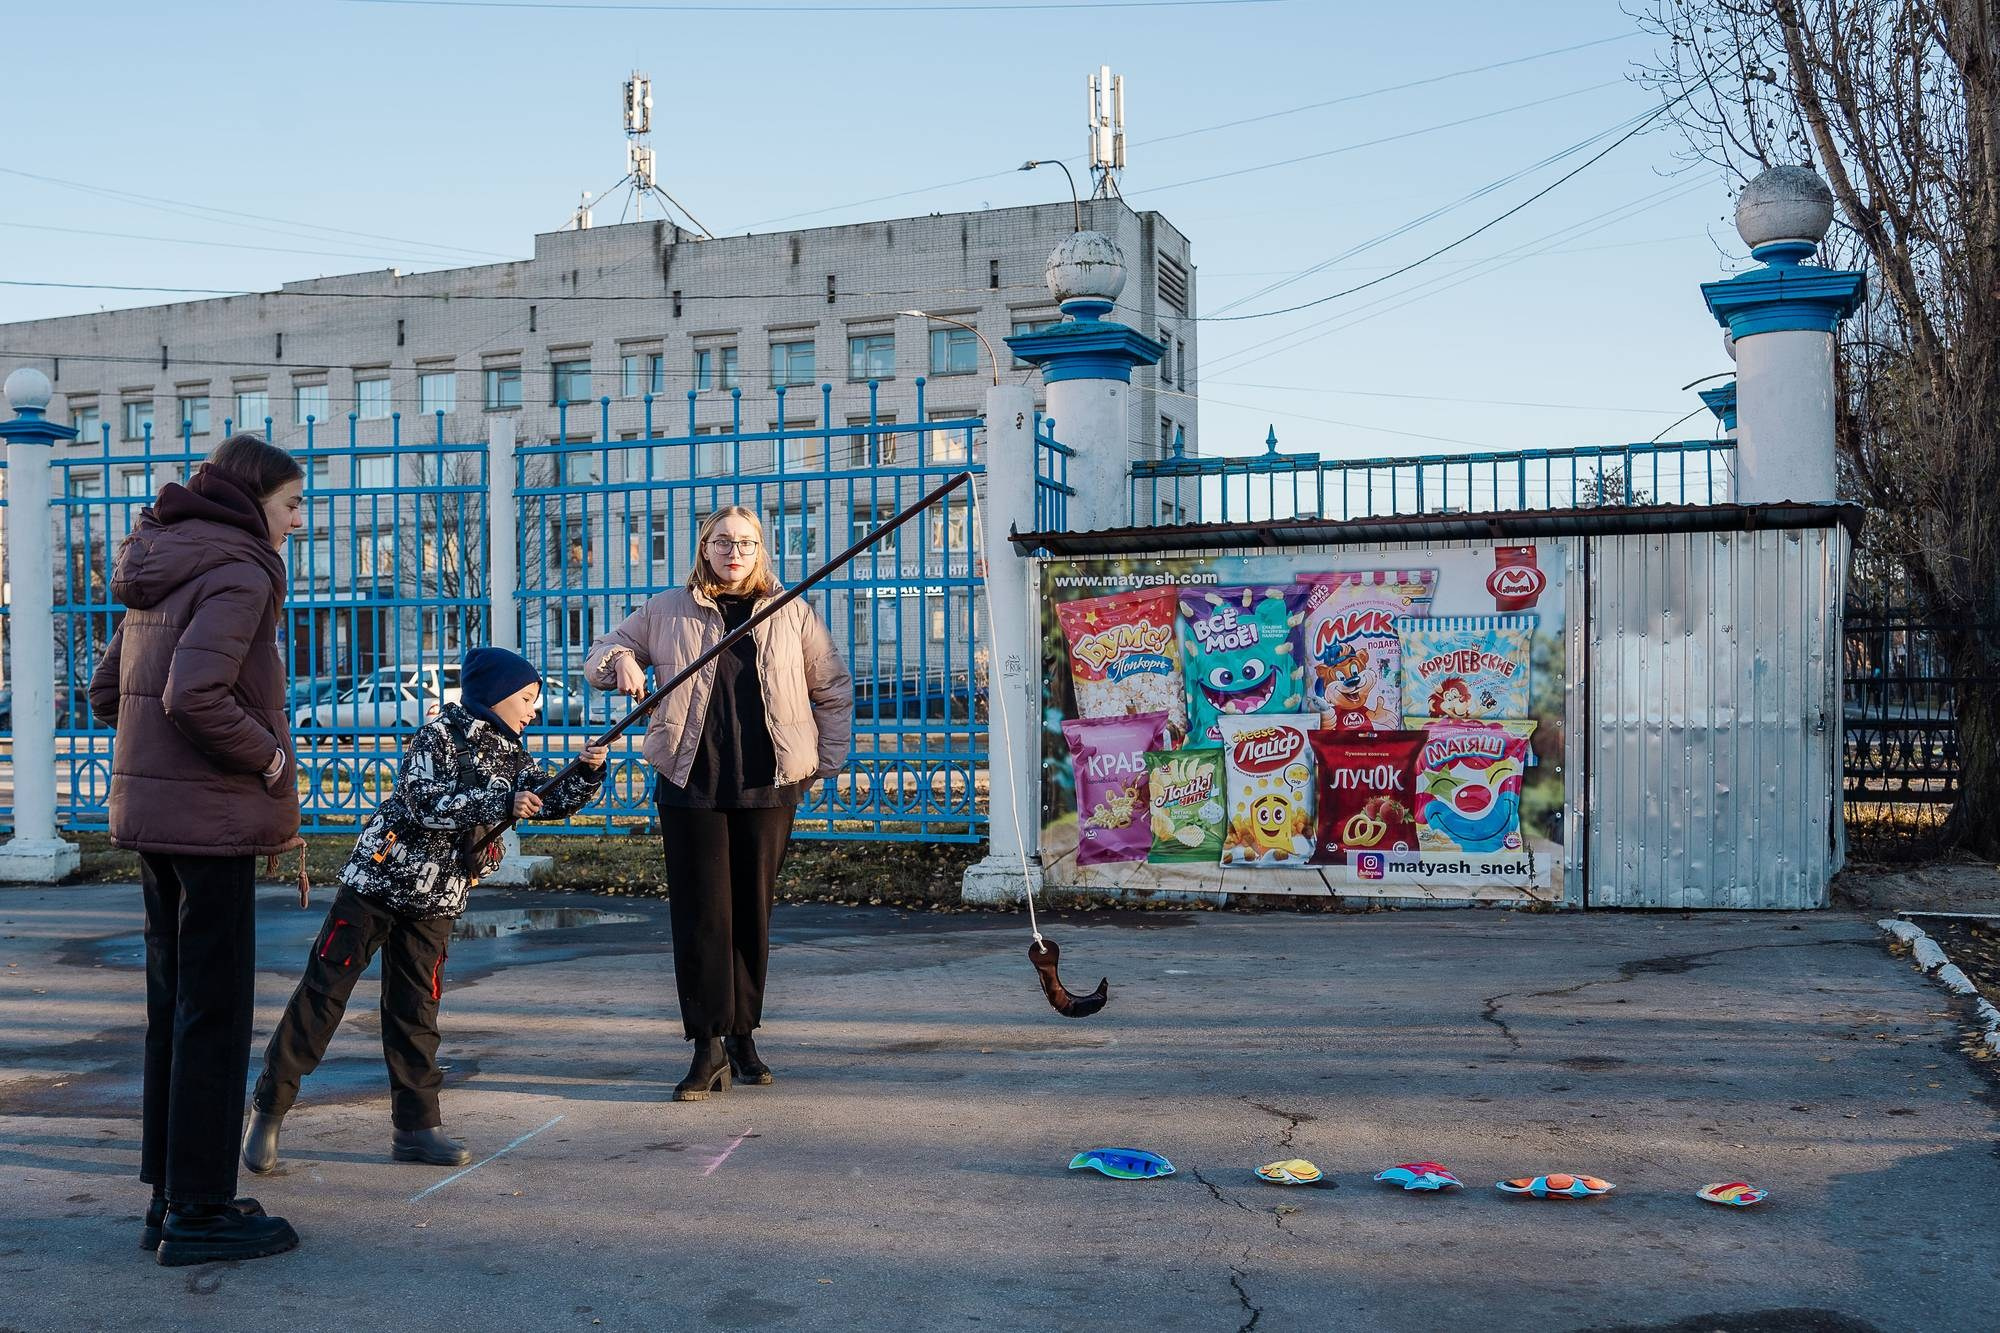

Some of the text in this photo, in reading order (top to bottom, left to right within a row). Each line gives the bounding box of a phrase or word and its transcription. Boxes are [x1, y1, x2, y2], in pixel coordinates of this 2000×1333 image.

[934, 564, 968, 579] ЦНТР
[1055, 572, 1218, 589] www.matyash.com
[1307, 584, 1329, 609] ПРИЗ
[1193, 608, 1238, 641] ВСЁ
[1314, 610, 1399, 657] МИК
[1205, 625, 1259, 653] МОЁ!
[1417, 649, 1516, 679] КОРОЛЕВСКИЕ
[1238, 732, 1300, 765] Лайф
[1427, 736, 1503, 764] МАТЯШ
[1088, 750, 1147, 778] КРАБ
[1329, 765, 1405, 791] ЛУЧОК
[1179, 790, 1210, 806] ЧИПС
[1388, 860, 1529, 876] matyash_snek
